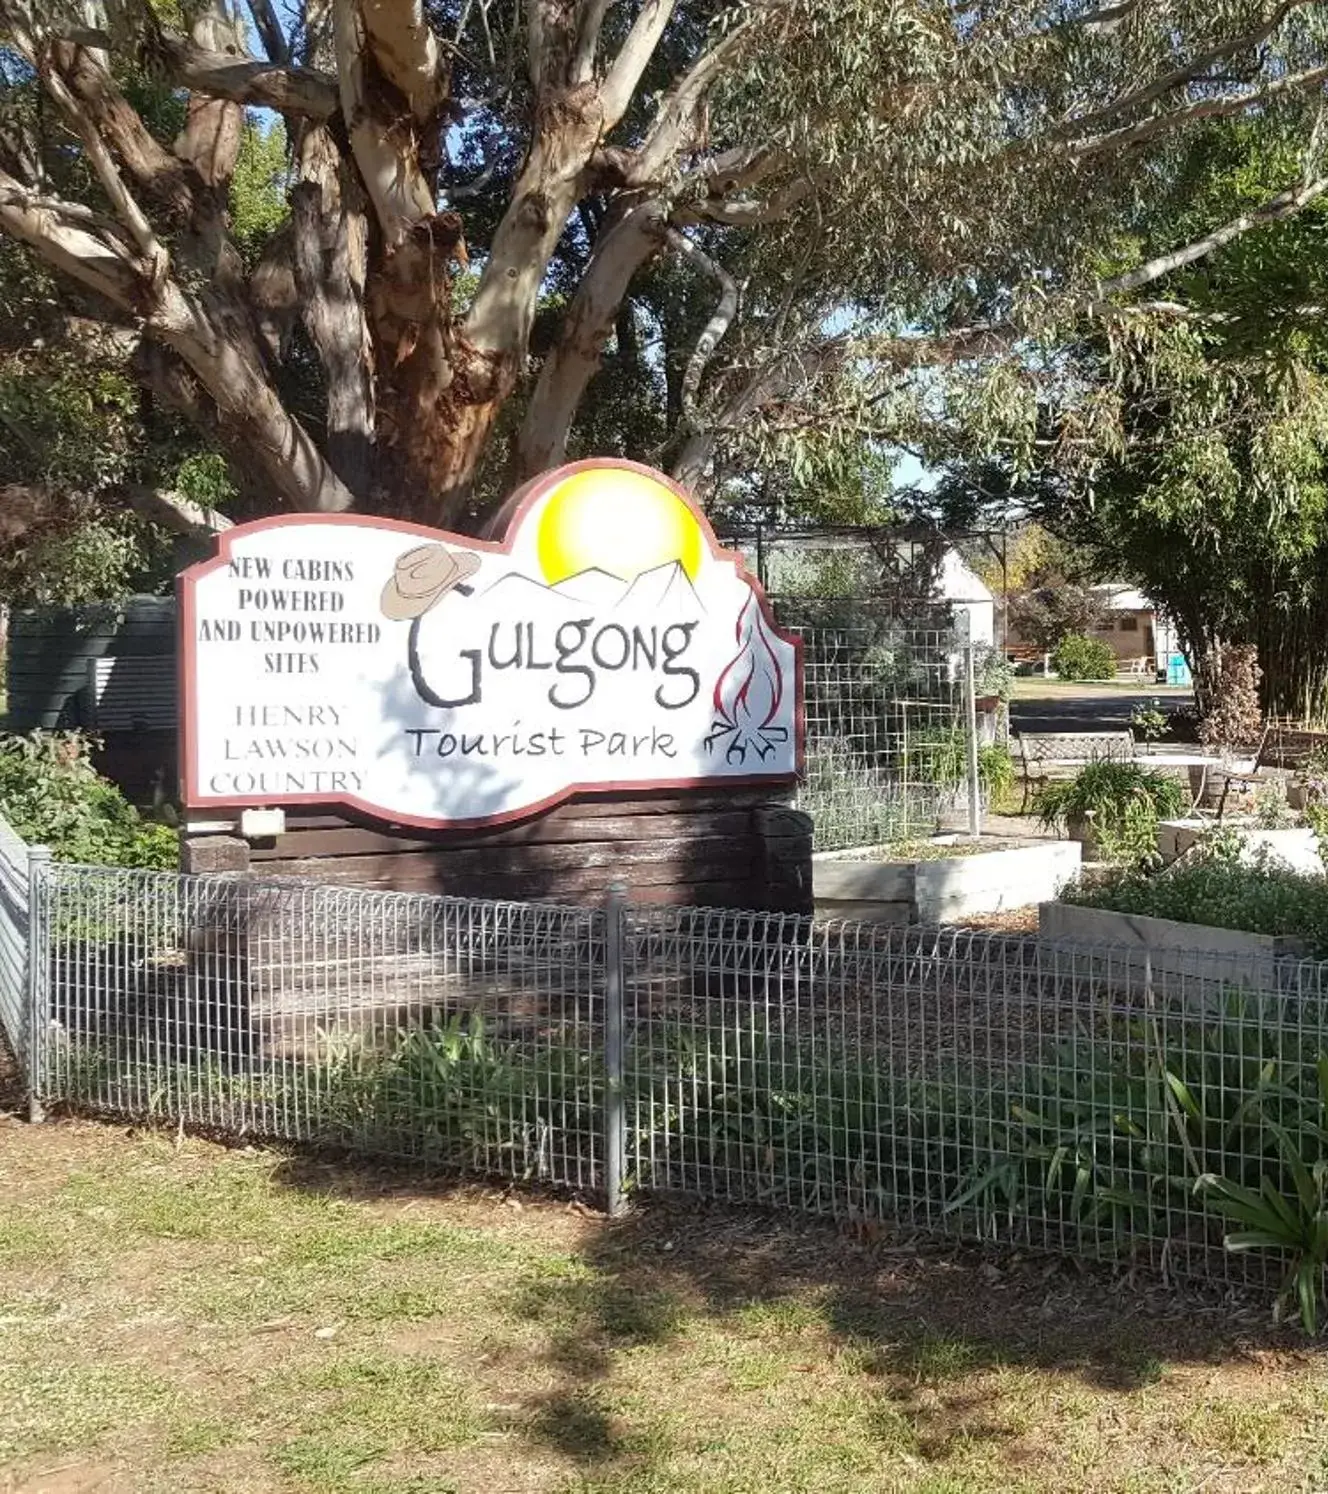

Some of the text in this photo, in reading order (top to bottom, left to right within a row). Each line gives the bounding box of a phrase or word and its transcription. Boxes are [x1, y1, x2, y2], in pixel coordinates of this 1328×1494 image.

[227, 556, 355, 582] NEW CABINS
[238, 588, 345, 613] POWERED
[198, 619, 382, 645] AND UNPOWERED
[264, 652, 320, 674] SITES
[234, 704, 348, 727] HENRY
[224, 738, 358, 761] LAWSON
[405, 720, 678, 758] Tourist Park
[209, 770, 368, 794] COUNTRY
